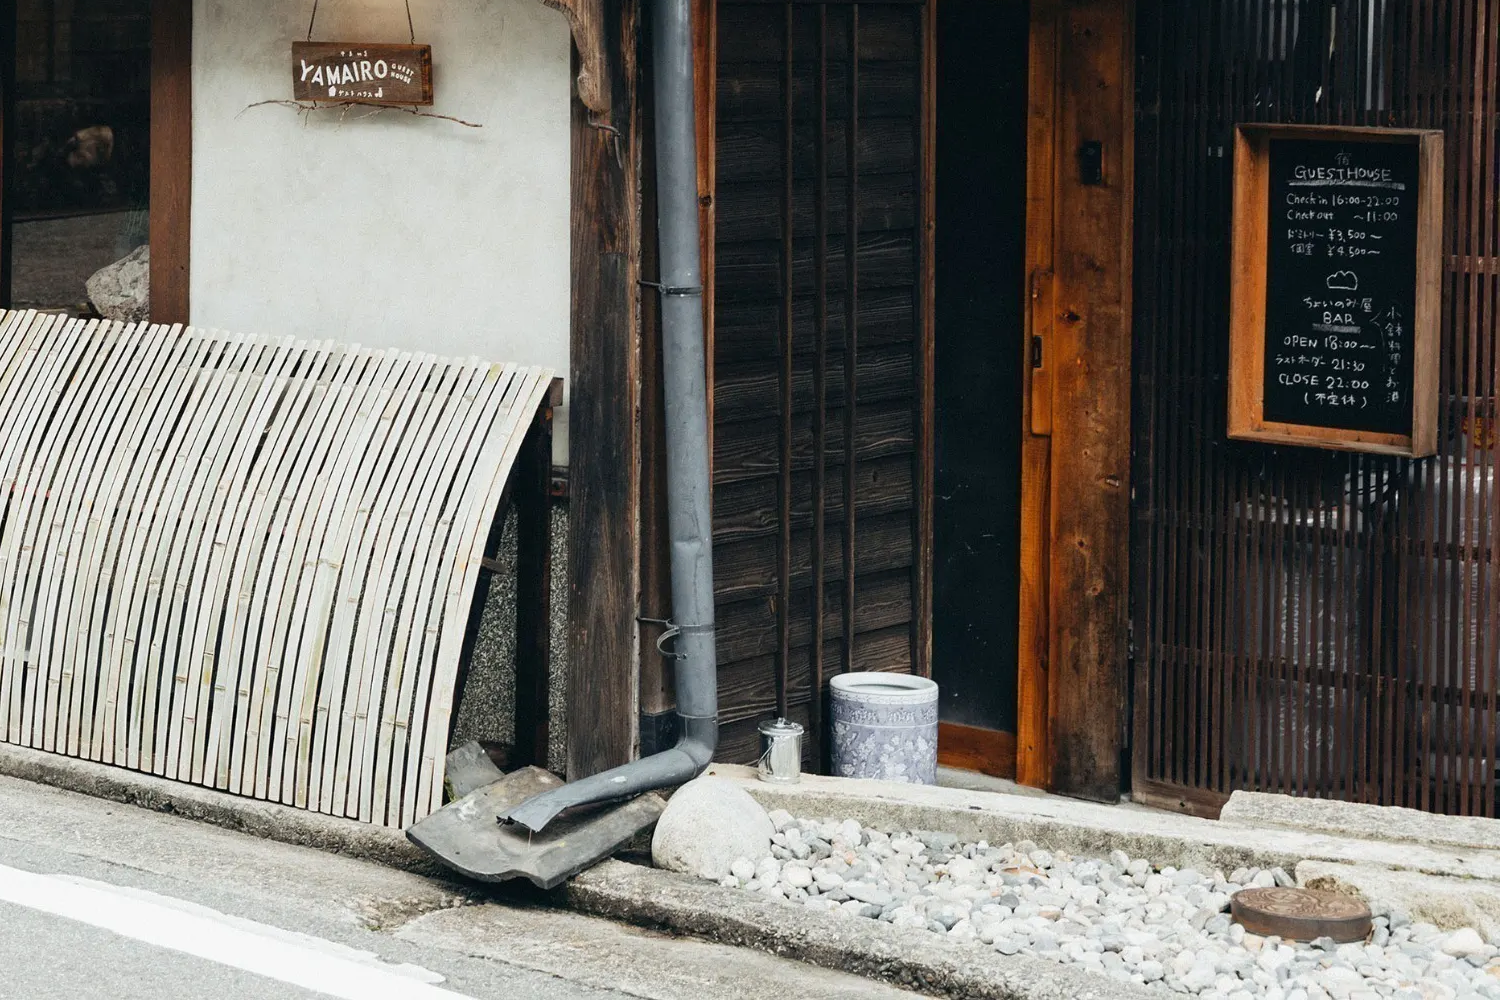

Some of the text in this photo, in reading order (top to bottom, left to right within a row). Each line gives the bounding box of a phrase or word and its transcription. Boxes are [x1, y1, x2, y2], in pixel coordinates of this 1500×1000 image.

[300, 59, 388, 86] YAMAIRO
[391, 63, 415, 77] GUEST
[390, 72, 412, 84] HOUSE
[1286, 192, 1315, 204] Check
[1287, 209, 1315, 220] Check
[1317, 211, 1334, 220] out
[1323, 312, 1355, 324] BAR
[1284, 335, 1318, 347] OPEN
[1332, 358, 1364, 371] 21:30
[1279, 373, 1369, 389] CLOSE 22:00
